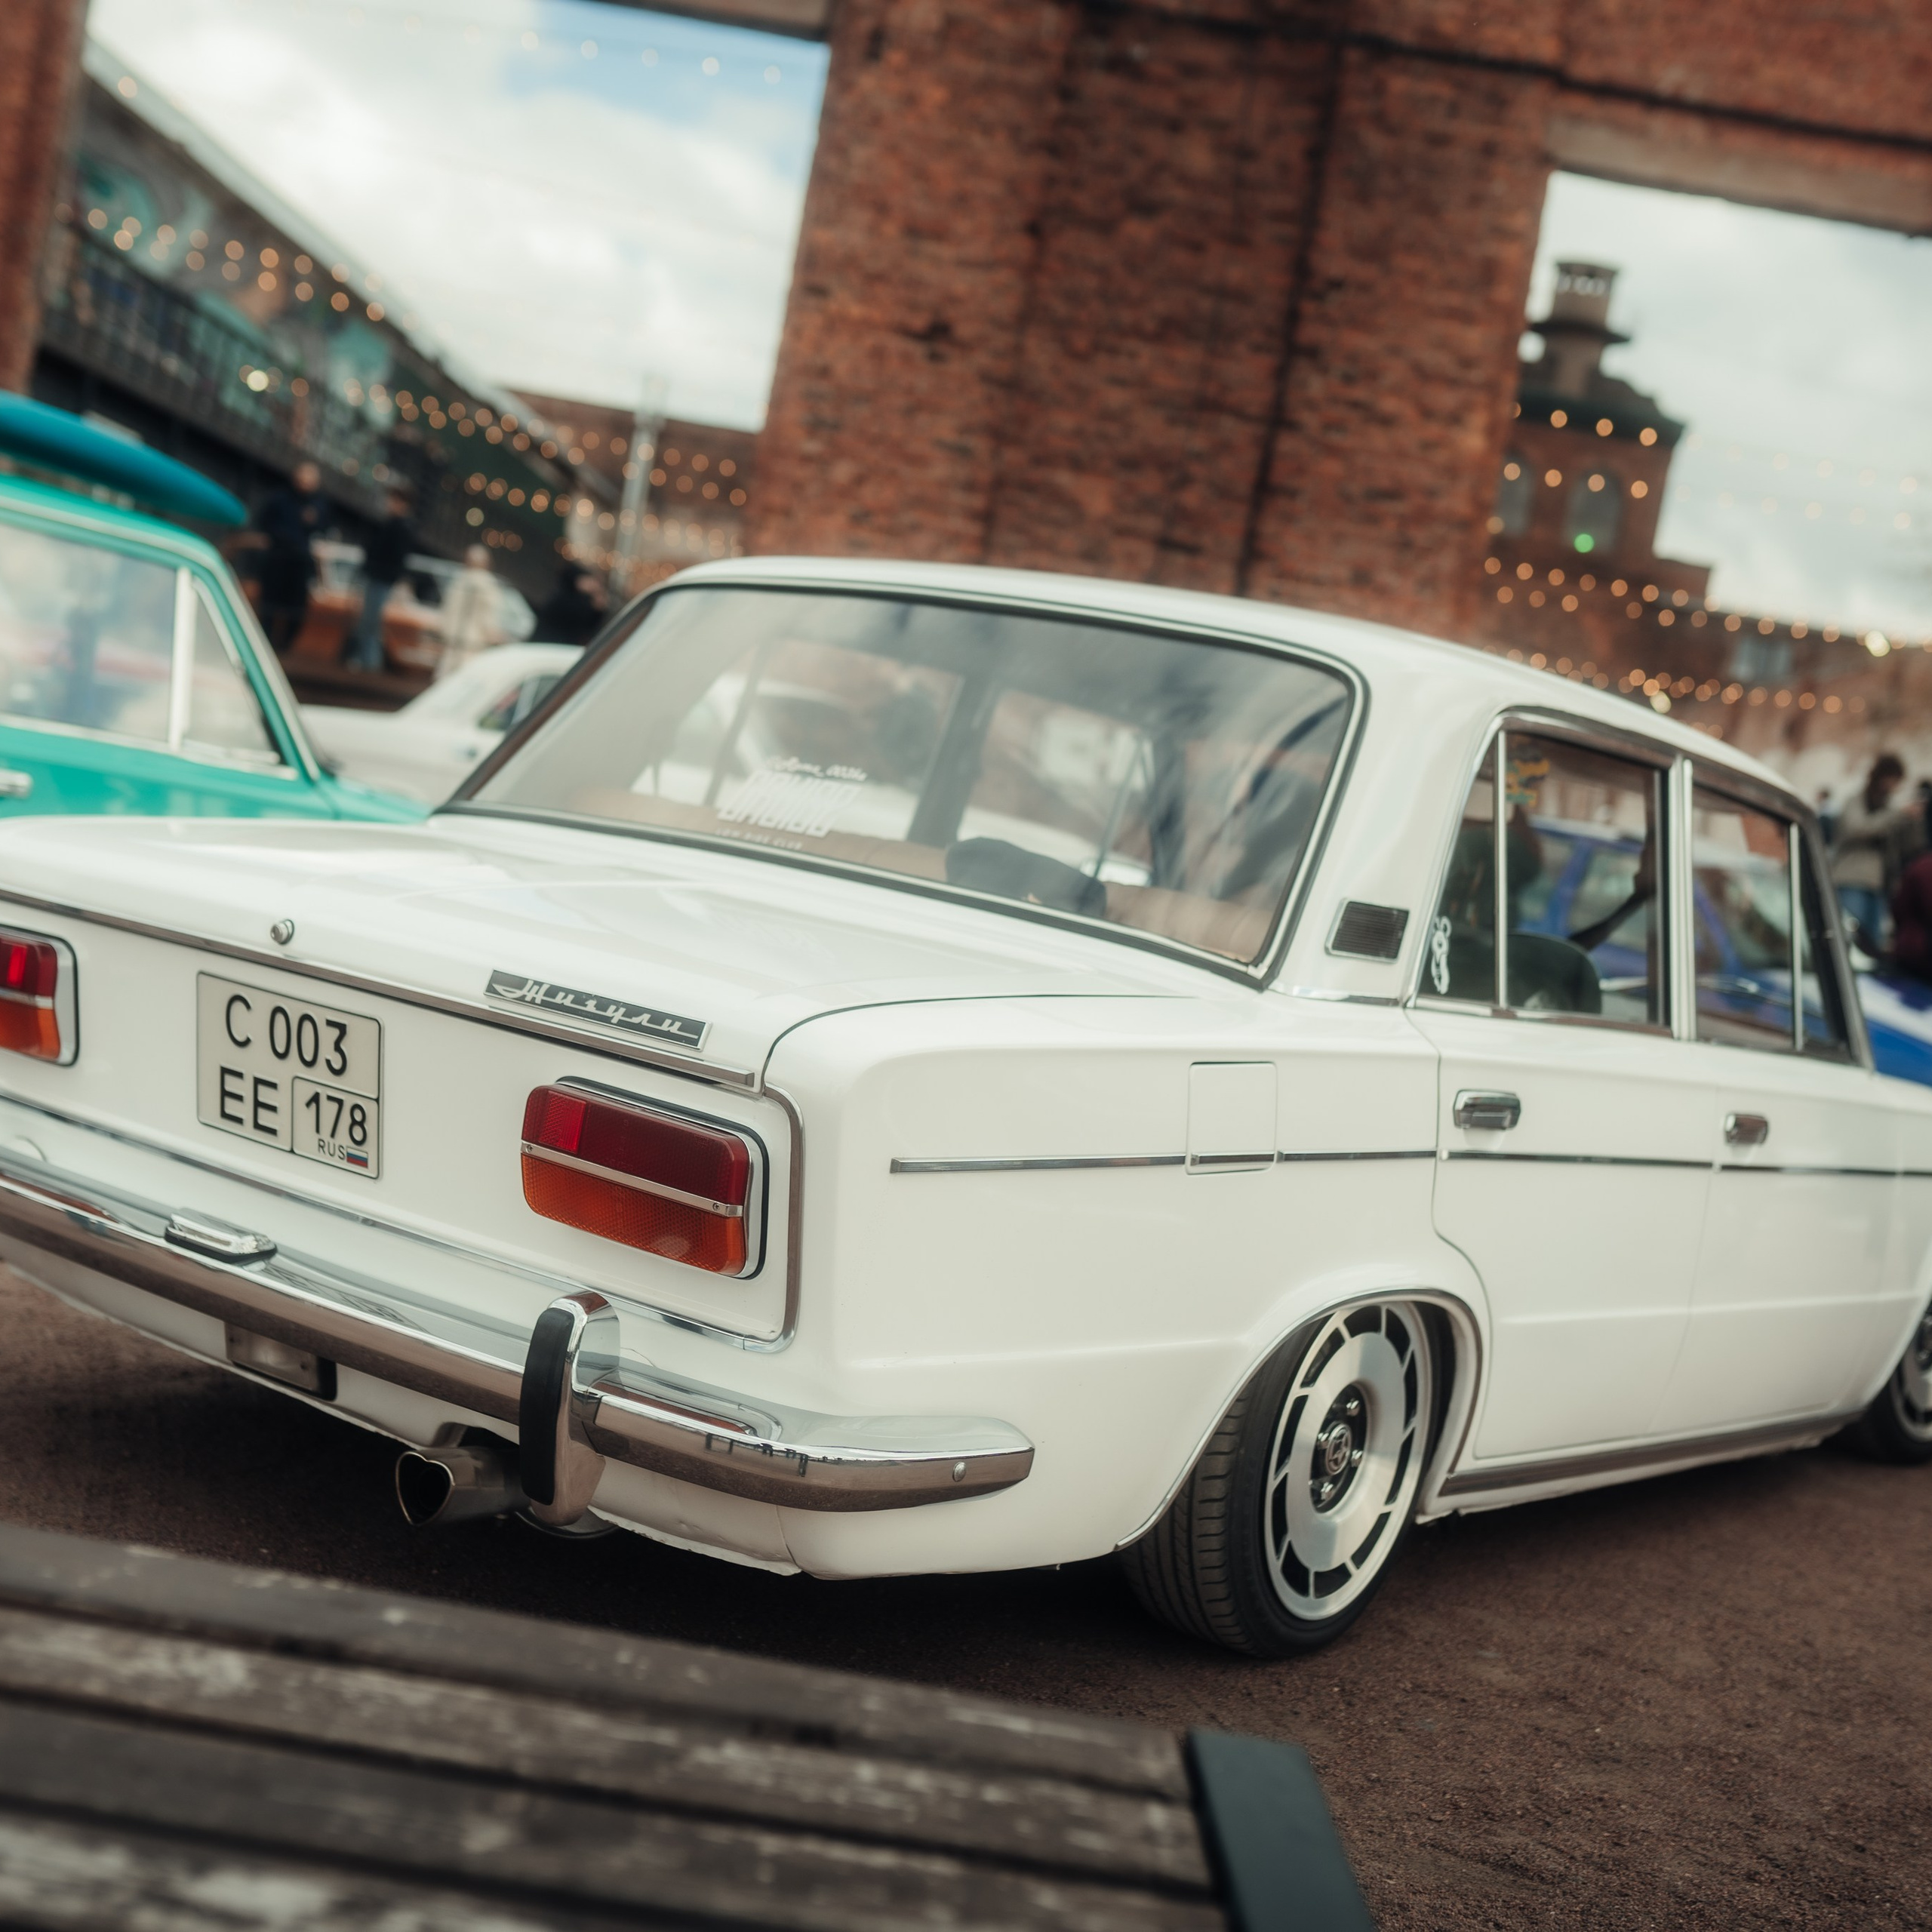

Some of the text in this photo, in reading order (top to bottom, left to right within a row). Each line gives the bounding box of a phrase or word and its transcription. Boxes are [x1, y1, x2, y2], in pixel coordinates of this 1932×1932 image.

[269, 1004, 348, 1077] 003
[305, 1091, 368, 1146] 178
[318, 1138, 346, 1161] RUS
